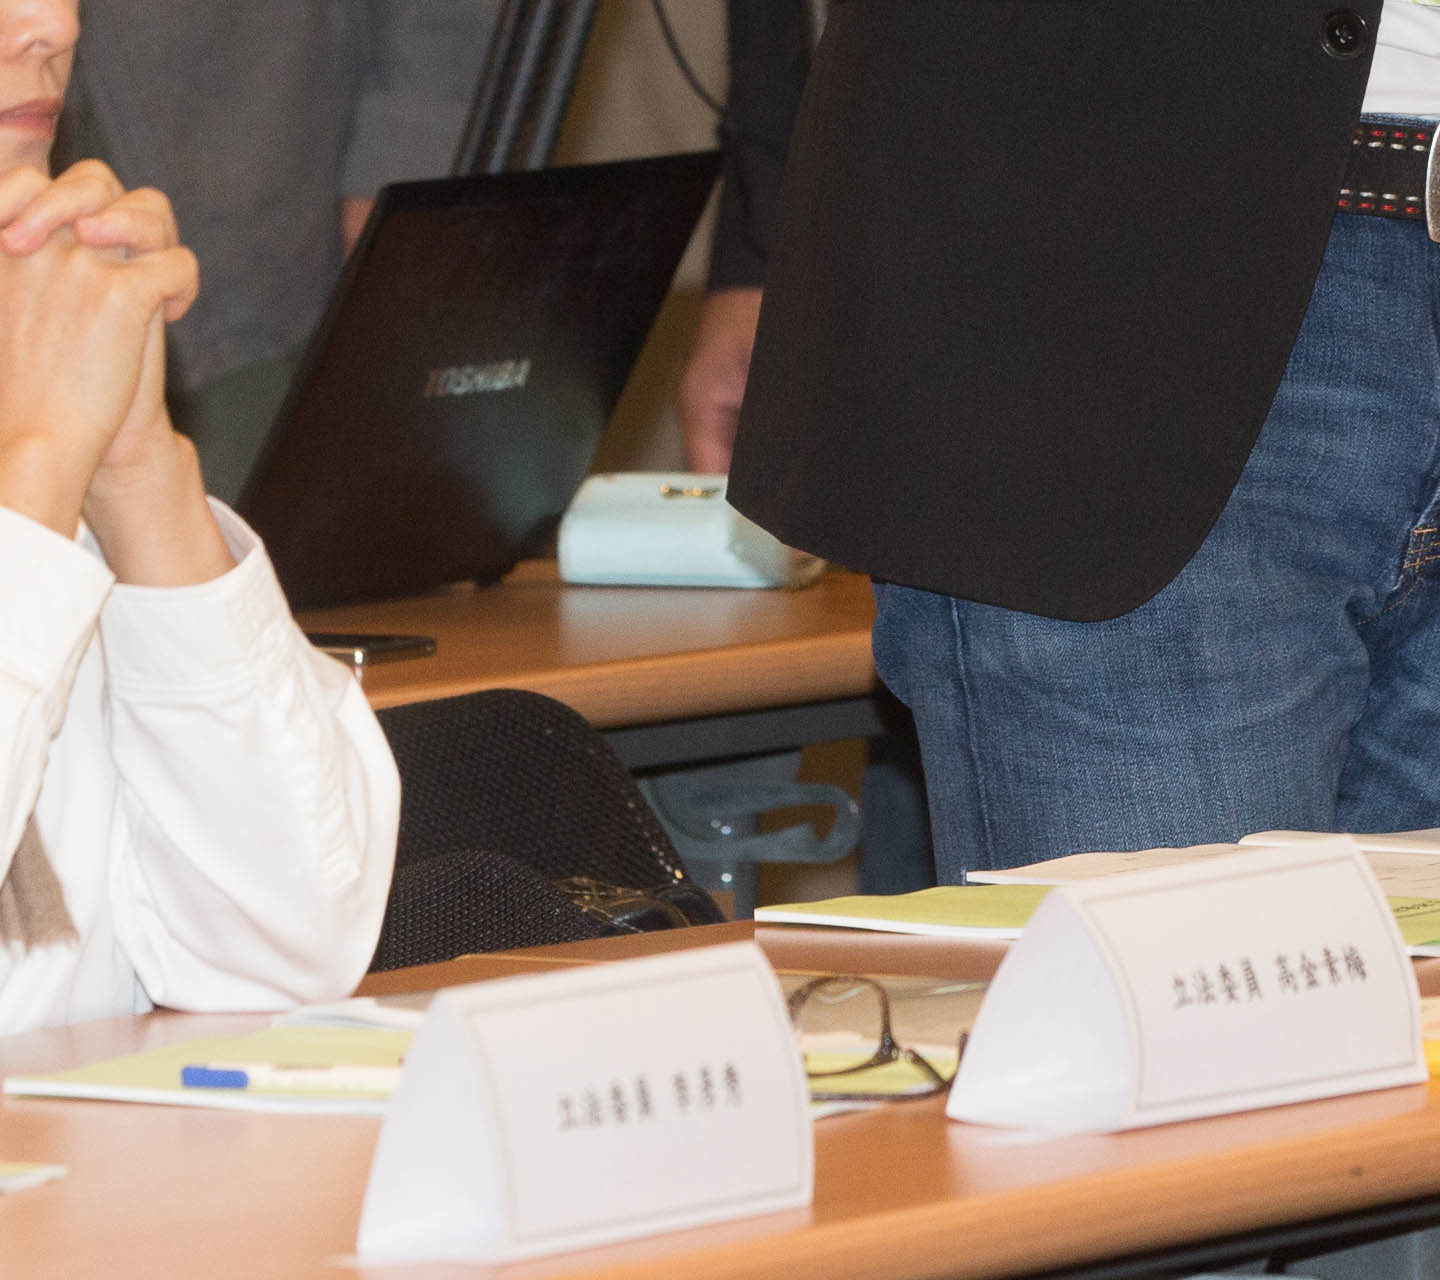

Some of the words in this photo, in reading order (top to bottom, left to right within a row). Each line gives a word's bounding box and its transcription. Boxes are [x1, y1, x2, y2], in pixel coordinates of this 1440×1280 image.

[1171, 954, 1265, 1009] 立法委員
[1275, 943, 1369, 995] 高金素梅
